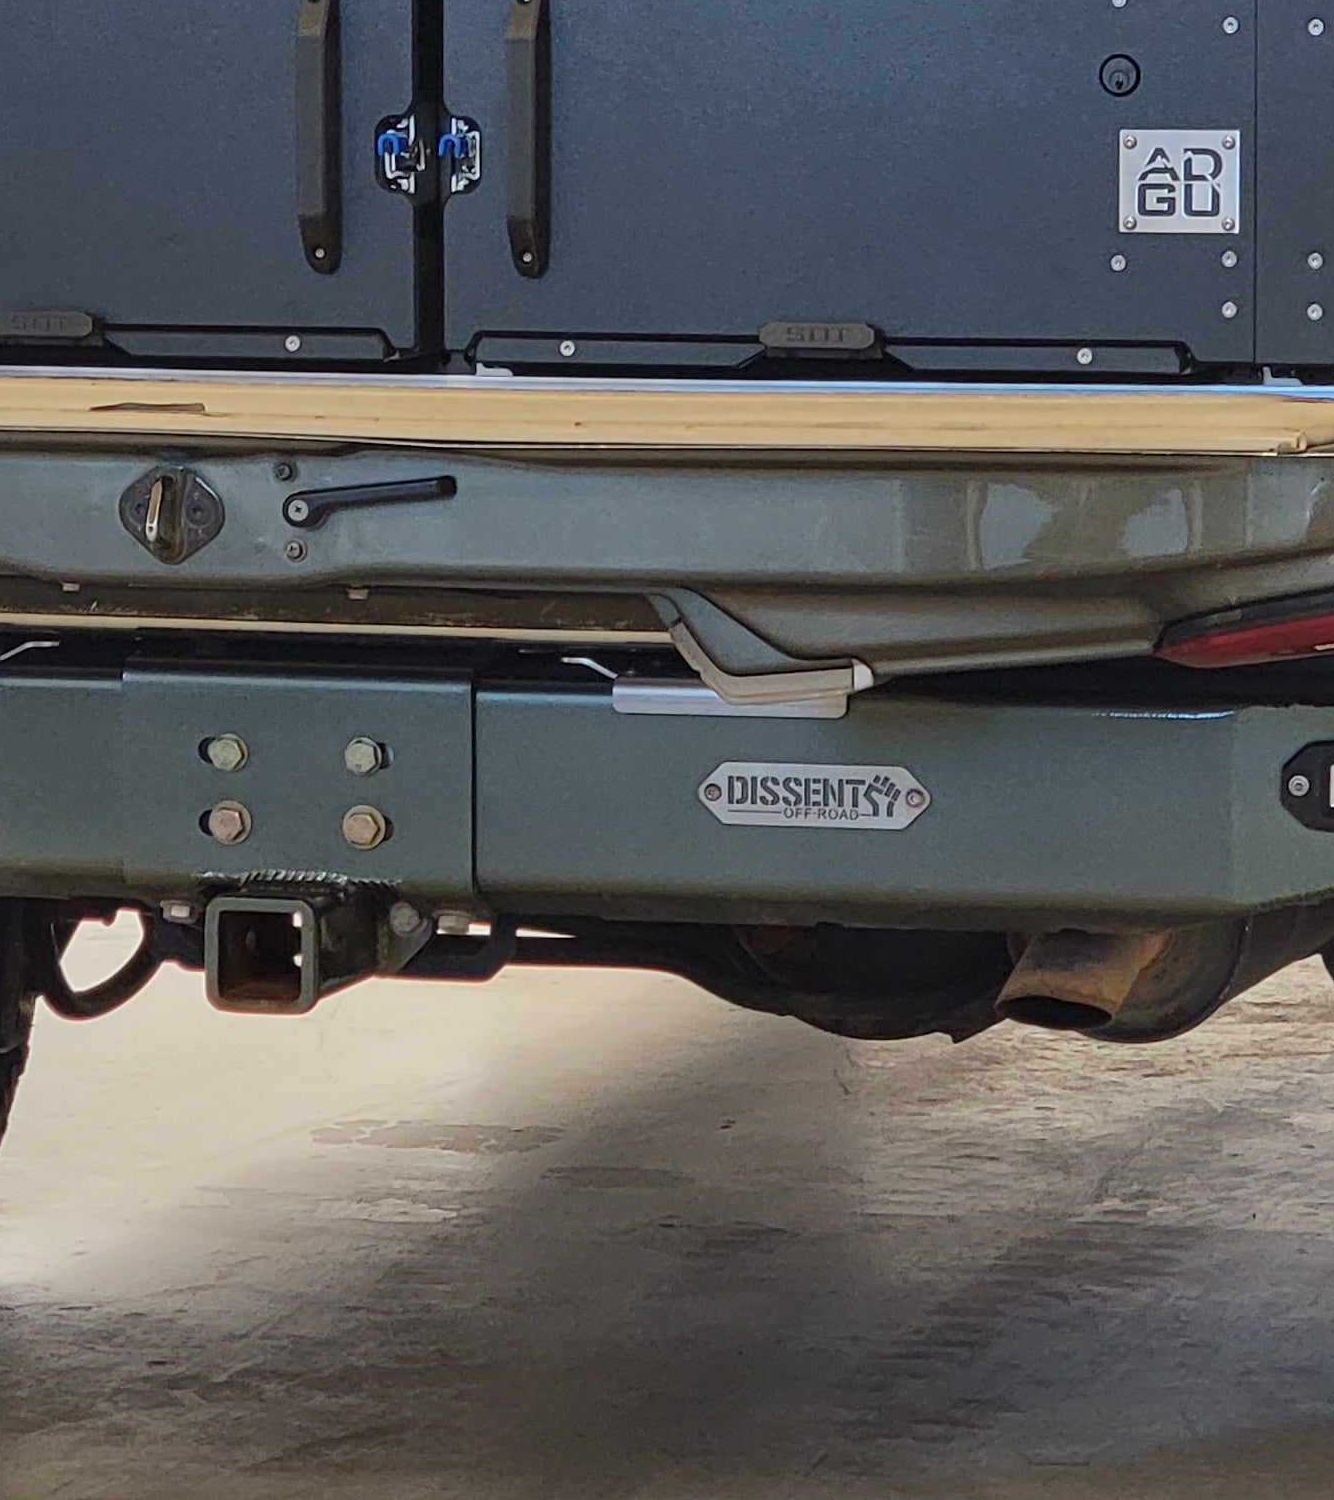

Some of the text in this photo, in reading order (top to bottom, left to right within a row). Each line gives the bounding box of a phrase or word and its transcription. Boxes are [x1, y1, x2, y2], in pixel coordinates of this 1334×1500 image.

[1137, 147, 1223, 181] AD
[1137, 183, 1221, 217] GU
[727, 775, 867, 809] DISSENT
[783, 807, 860, 821] OFF-ROAD
